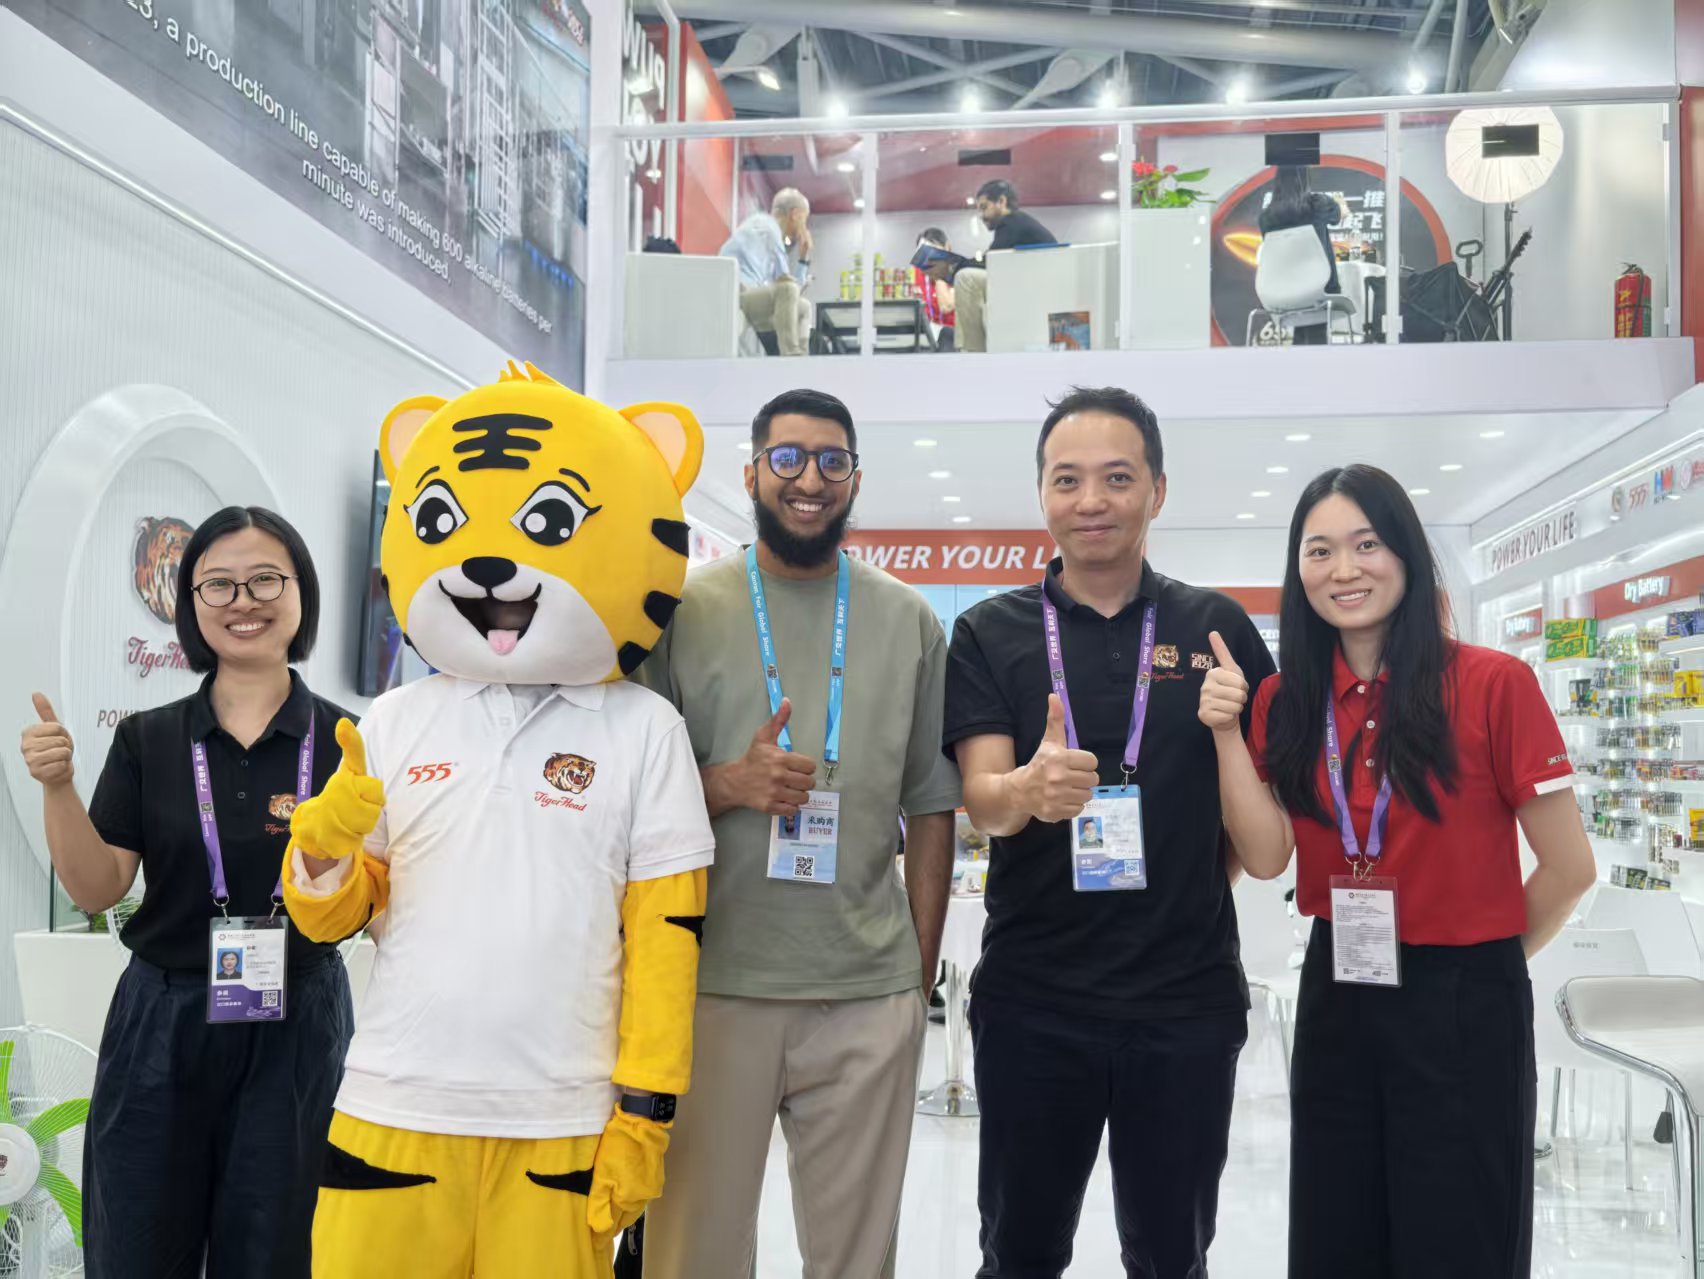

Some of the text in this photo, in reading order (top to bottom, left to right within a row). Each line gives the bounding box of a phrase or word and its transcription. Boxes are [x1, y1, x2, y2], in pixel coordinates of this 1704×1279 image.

[167, 17, 180, 42] a
[186, 32, 286, 125] production
[290, 109, 319, 150] line
[323, 141, 379, 197] capable
[382, 189, 397, 208] of
[398, 200, 441, 249] making
[442, 232, 463, 262] 600
[303, 159, 354, 209] minute
[357, 200, 385, 233] was
[1492, 511, 1575, 574] POWER YOUR LIFE
[942, 545, 1027, 569] YOUR
[1142, 645, 1151, 665] Share
[301, 775, 309, 796] Share
[407, 762, 453, 786] 555
[808, 827, 833, 836] BUYER
